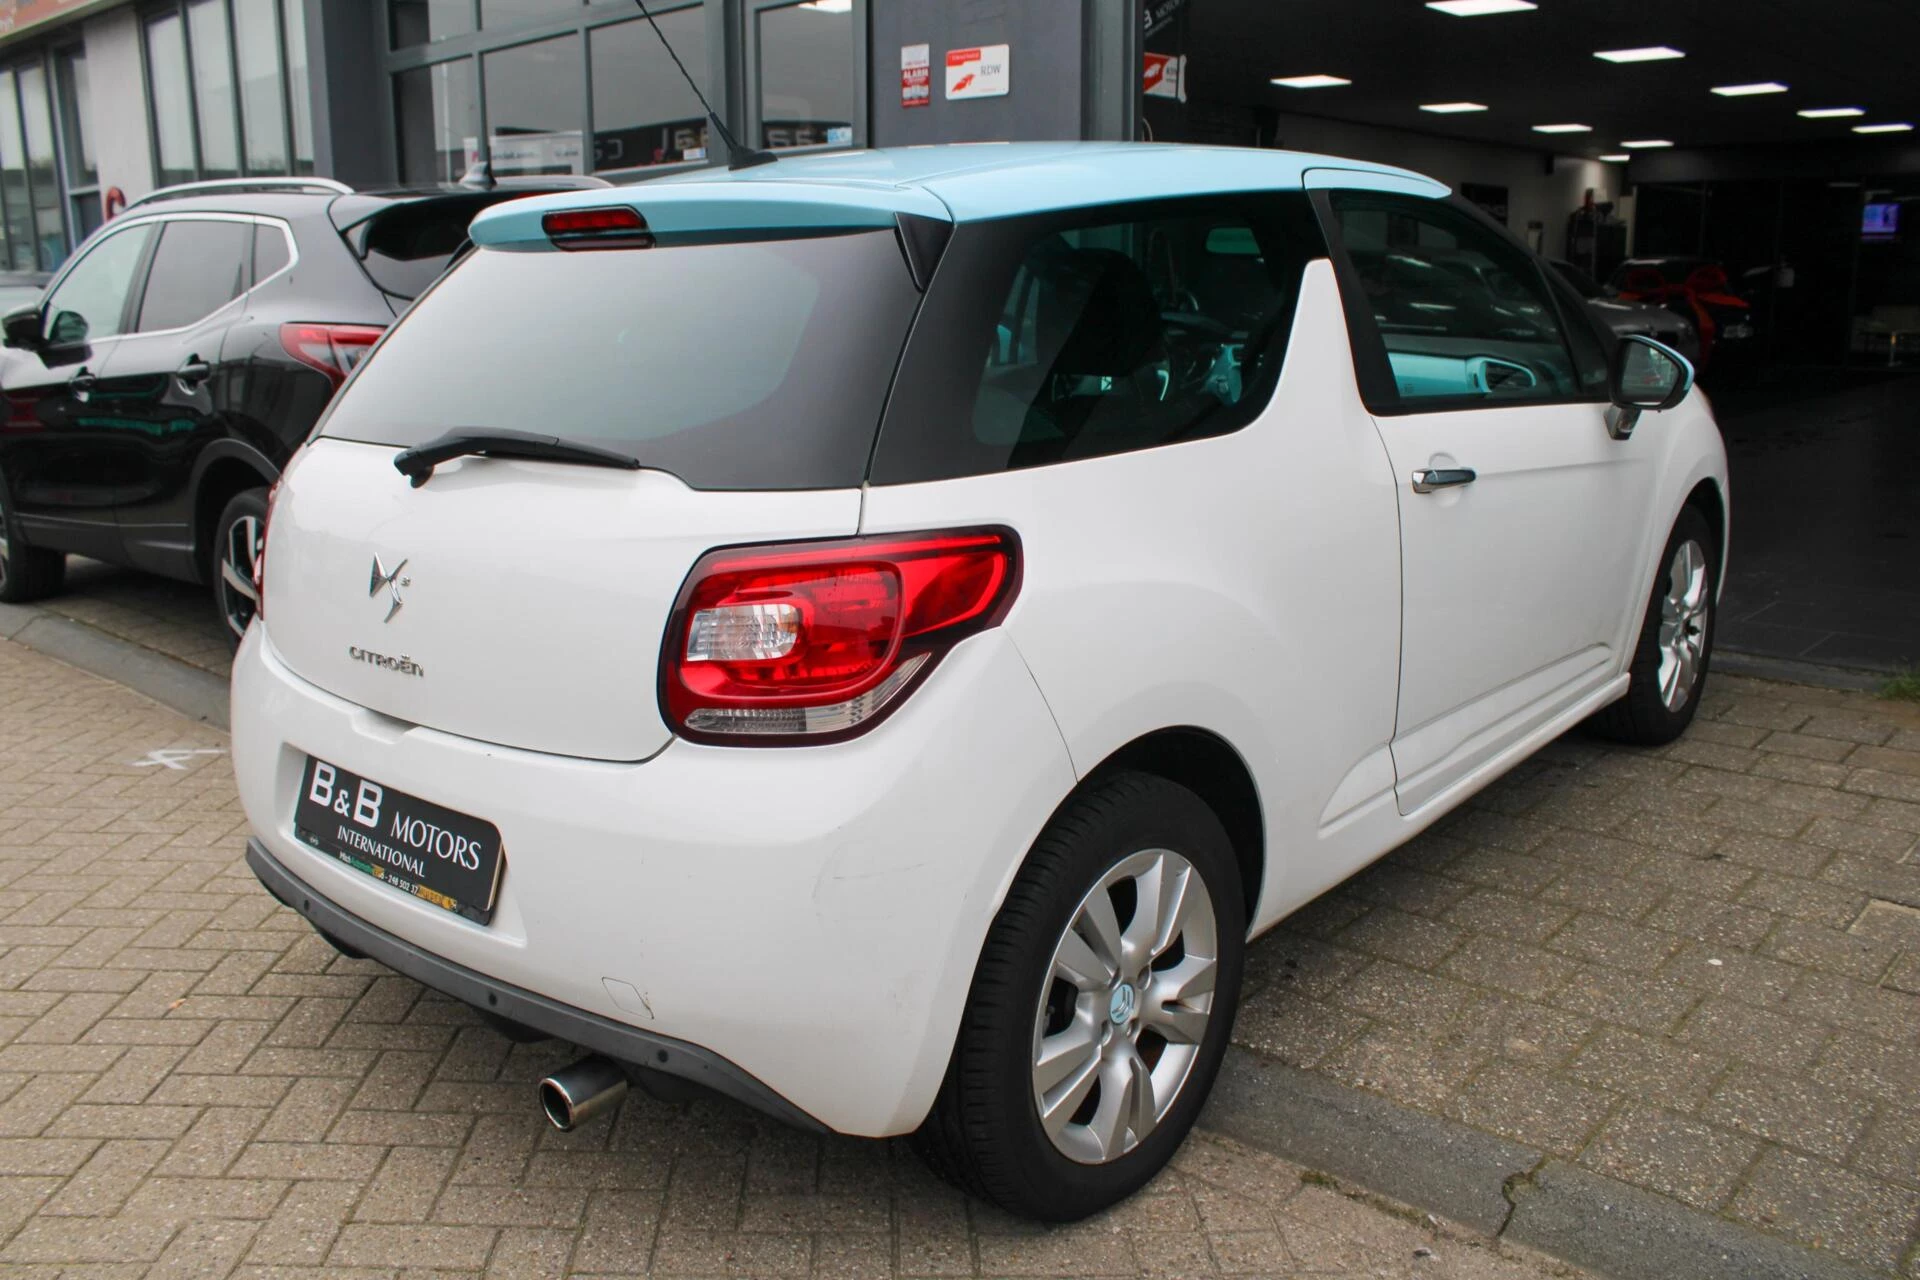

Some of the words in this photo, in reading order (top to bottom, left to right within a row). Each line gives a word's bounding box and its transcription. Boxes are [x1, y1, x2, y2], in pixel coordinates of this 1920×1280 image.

[903, 67, 929, 79] ALARM
[980, 64, 1002, 76] RDW
[337, 825, 425, 878] INTERNATIONAL
[390, 811, 482, 871] MOTORS
